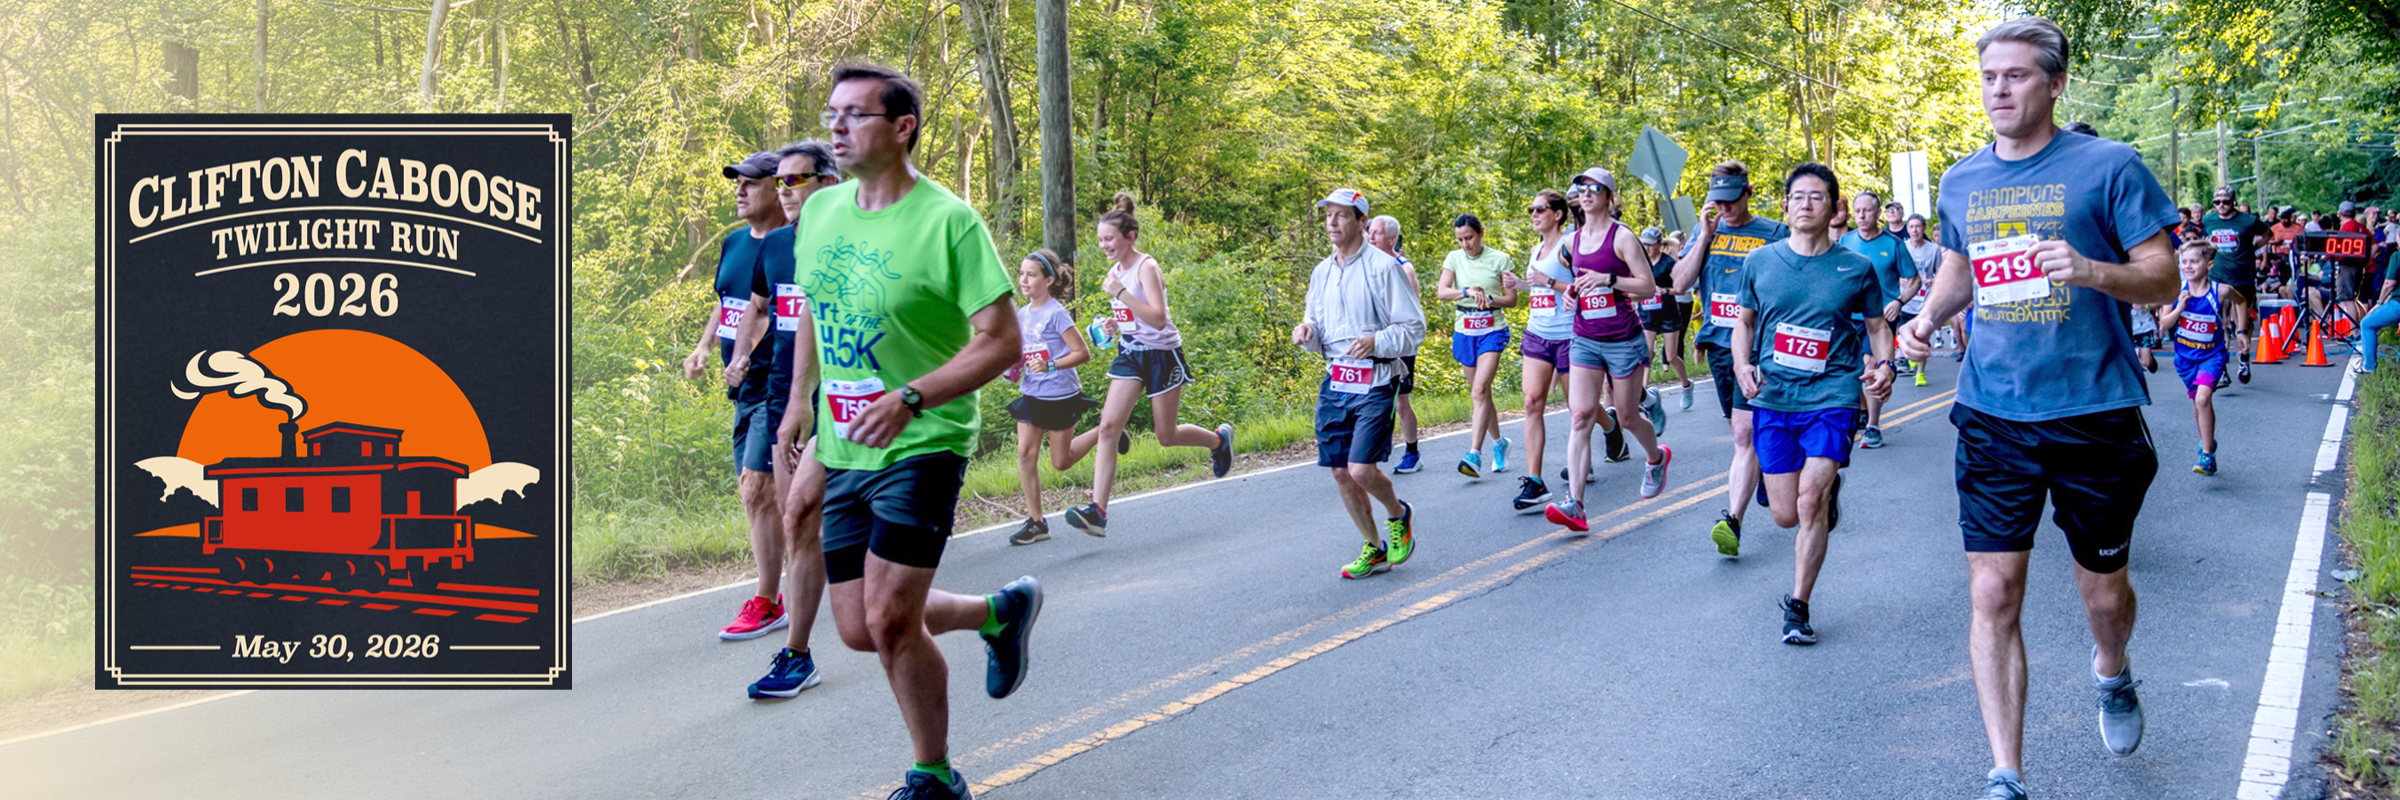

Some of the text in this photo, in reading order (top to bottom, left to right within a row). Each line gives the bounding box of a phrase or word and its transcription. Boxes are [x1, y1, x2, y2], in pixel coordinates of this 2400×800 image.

[1967, 184, 2066, 208] CHAMPIONS
[1966, 202, 2065, 222] CAMPEONES
[1710, 234, 1767, 252] LSU TIGERS
[1982, 255, 2032, 284] 219
[1532, 296, 1550, 307] 214
[1585, 296, 1608, 309] 199
[1718, 303, 1741, 317] 198
[844, 313, 883, 329] OF THE
[1468, 318, 1488, 329] 762
[2186, 319, 2209, 333] 748
[838, 328, 887, 371] 5K
[1785, 337, 1819, 357] 175
[1339, 367, 1362, 383] 761
